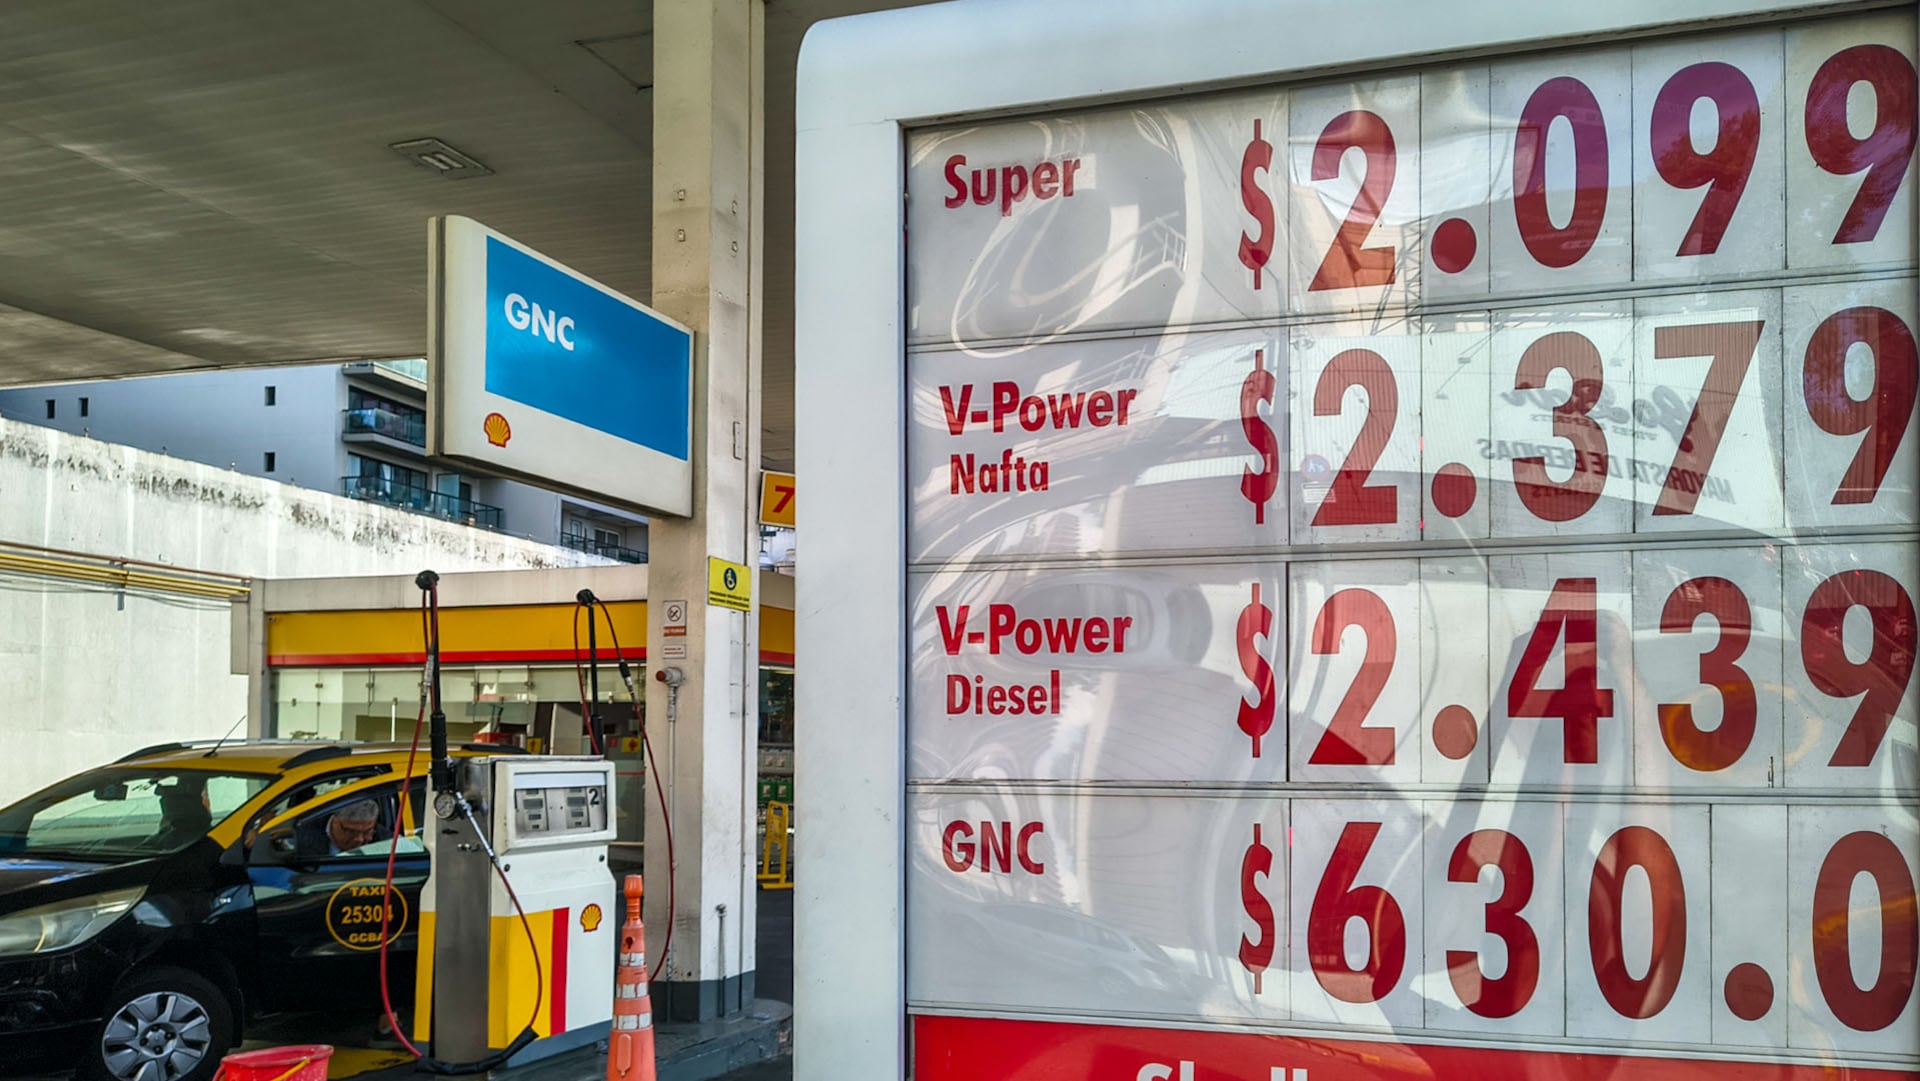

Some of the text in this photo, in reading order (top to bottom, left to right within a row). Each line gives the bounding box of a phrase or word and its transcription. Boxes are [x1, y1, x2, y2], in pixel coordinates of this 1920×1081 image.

[944, 154, 1081, 217] Super
[504, 292, 575, 352] GNC
[938, 380, 1138, 436] V-Power
[950, 448, 1049, 495] Nafta
[935, 603, 1133, 656] V-Power
[946, 669, 1061, 715] Diesel
[588, 788, 600, 806] 2
[942, 819, 1044, 874] GNC
[349, 886, 386, 897] TAXI
